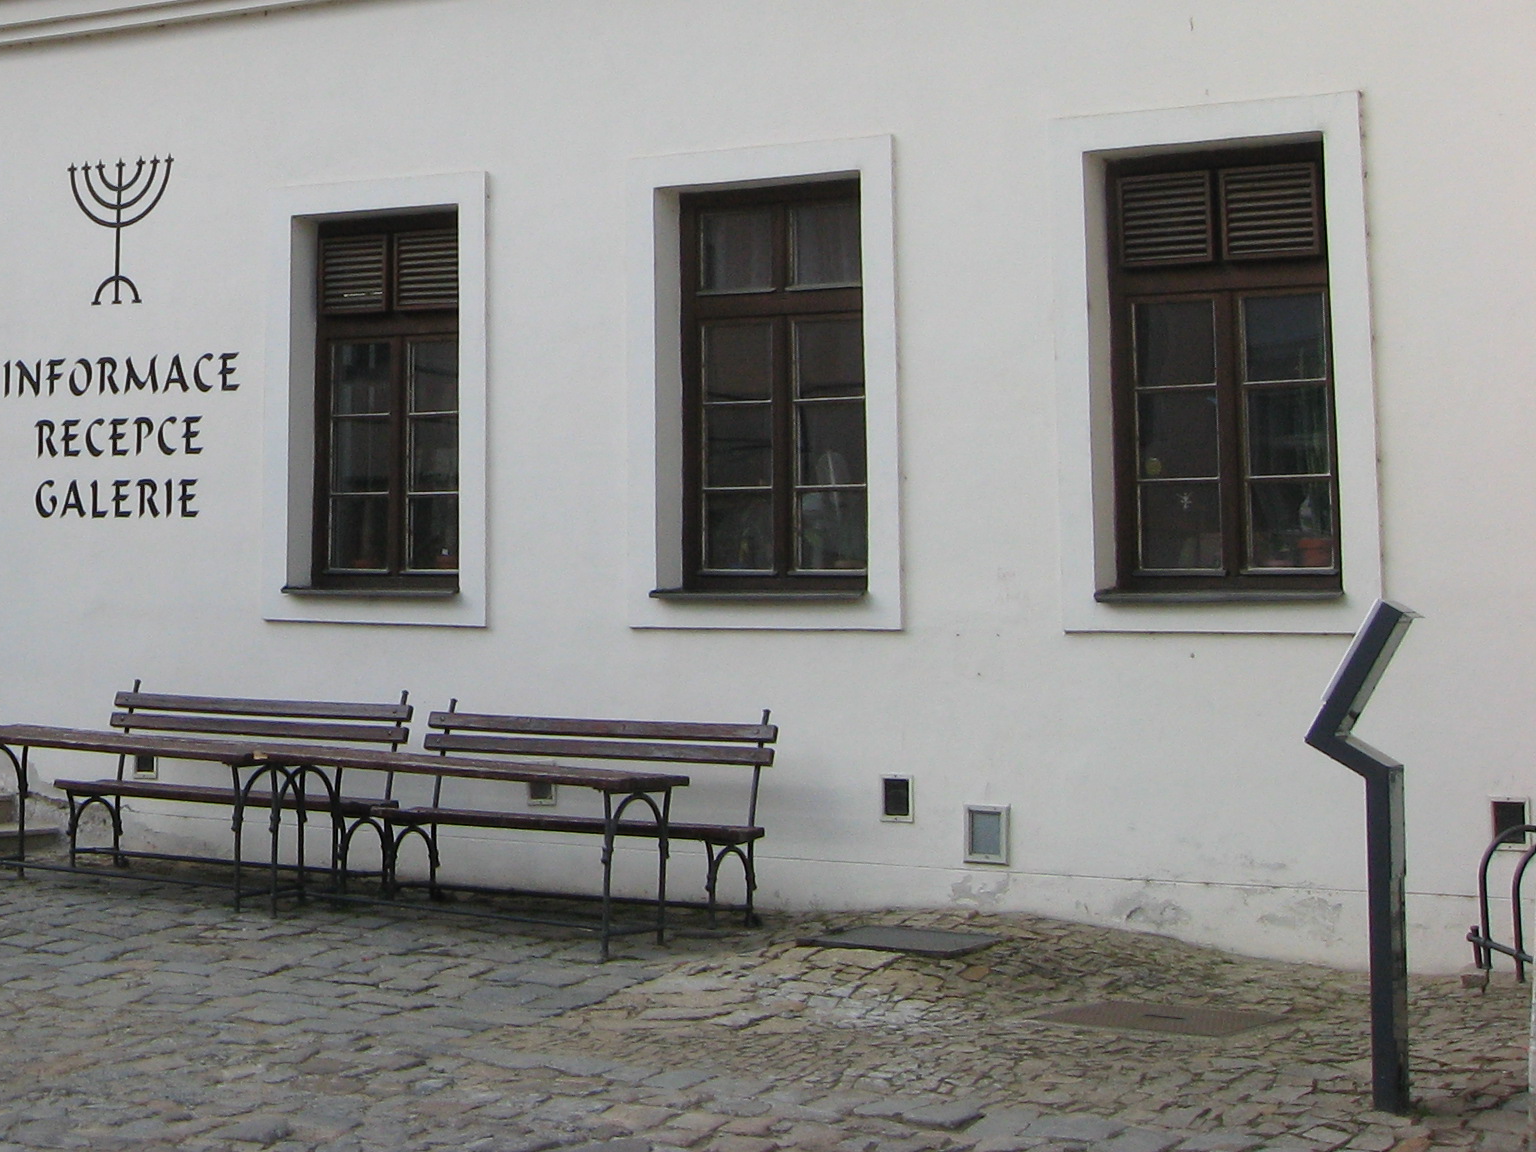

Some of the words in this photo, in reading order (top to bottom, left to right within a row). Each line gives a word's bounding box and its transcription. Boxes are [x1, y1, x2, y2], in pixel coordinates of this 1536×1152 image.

[3, 351, 241, 398] INFORMACE
[33, 415, 204, 459] RECEPCE
[34, 478, 200, 520] GALERIE
